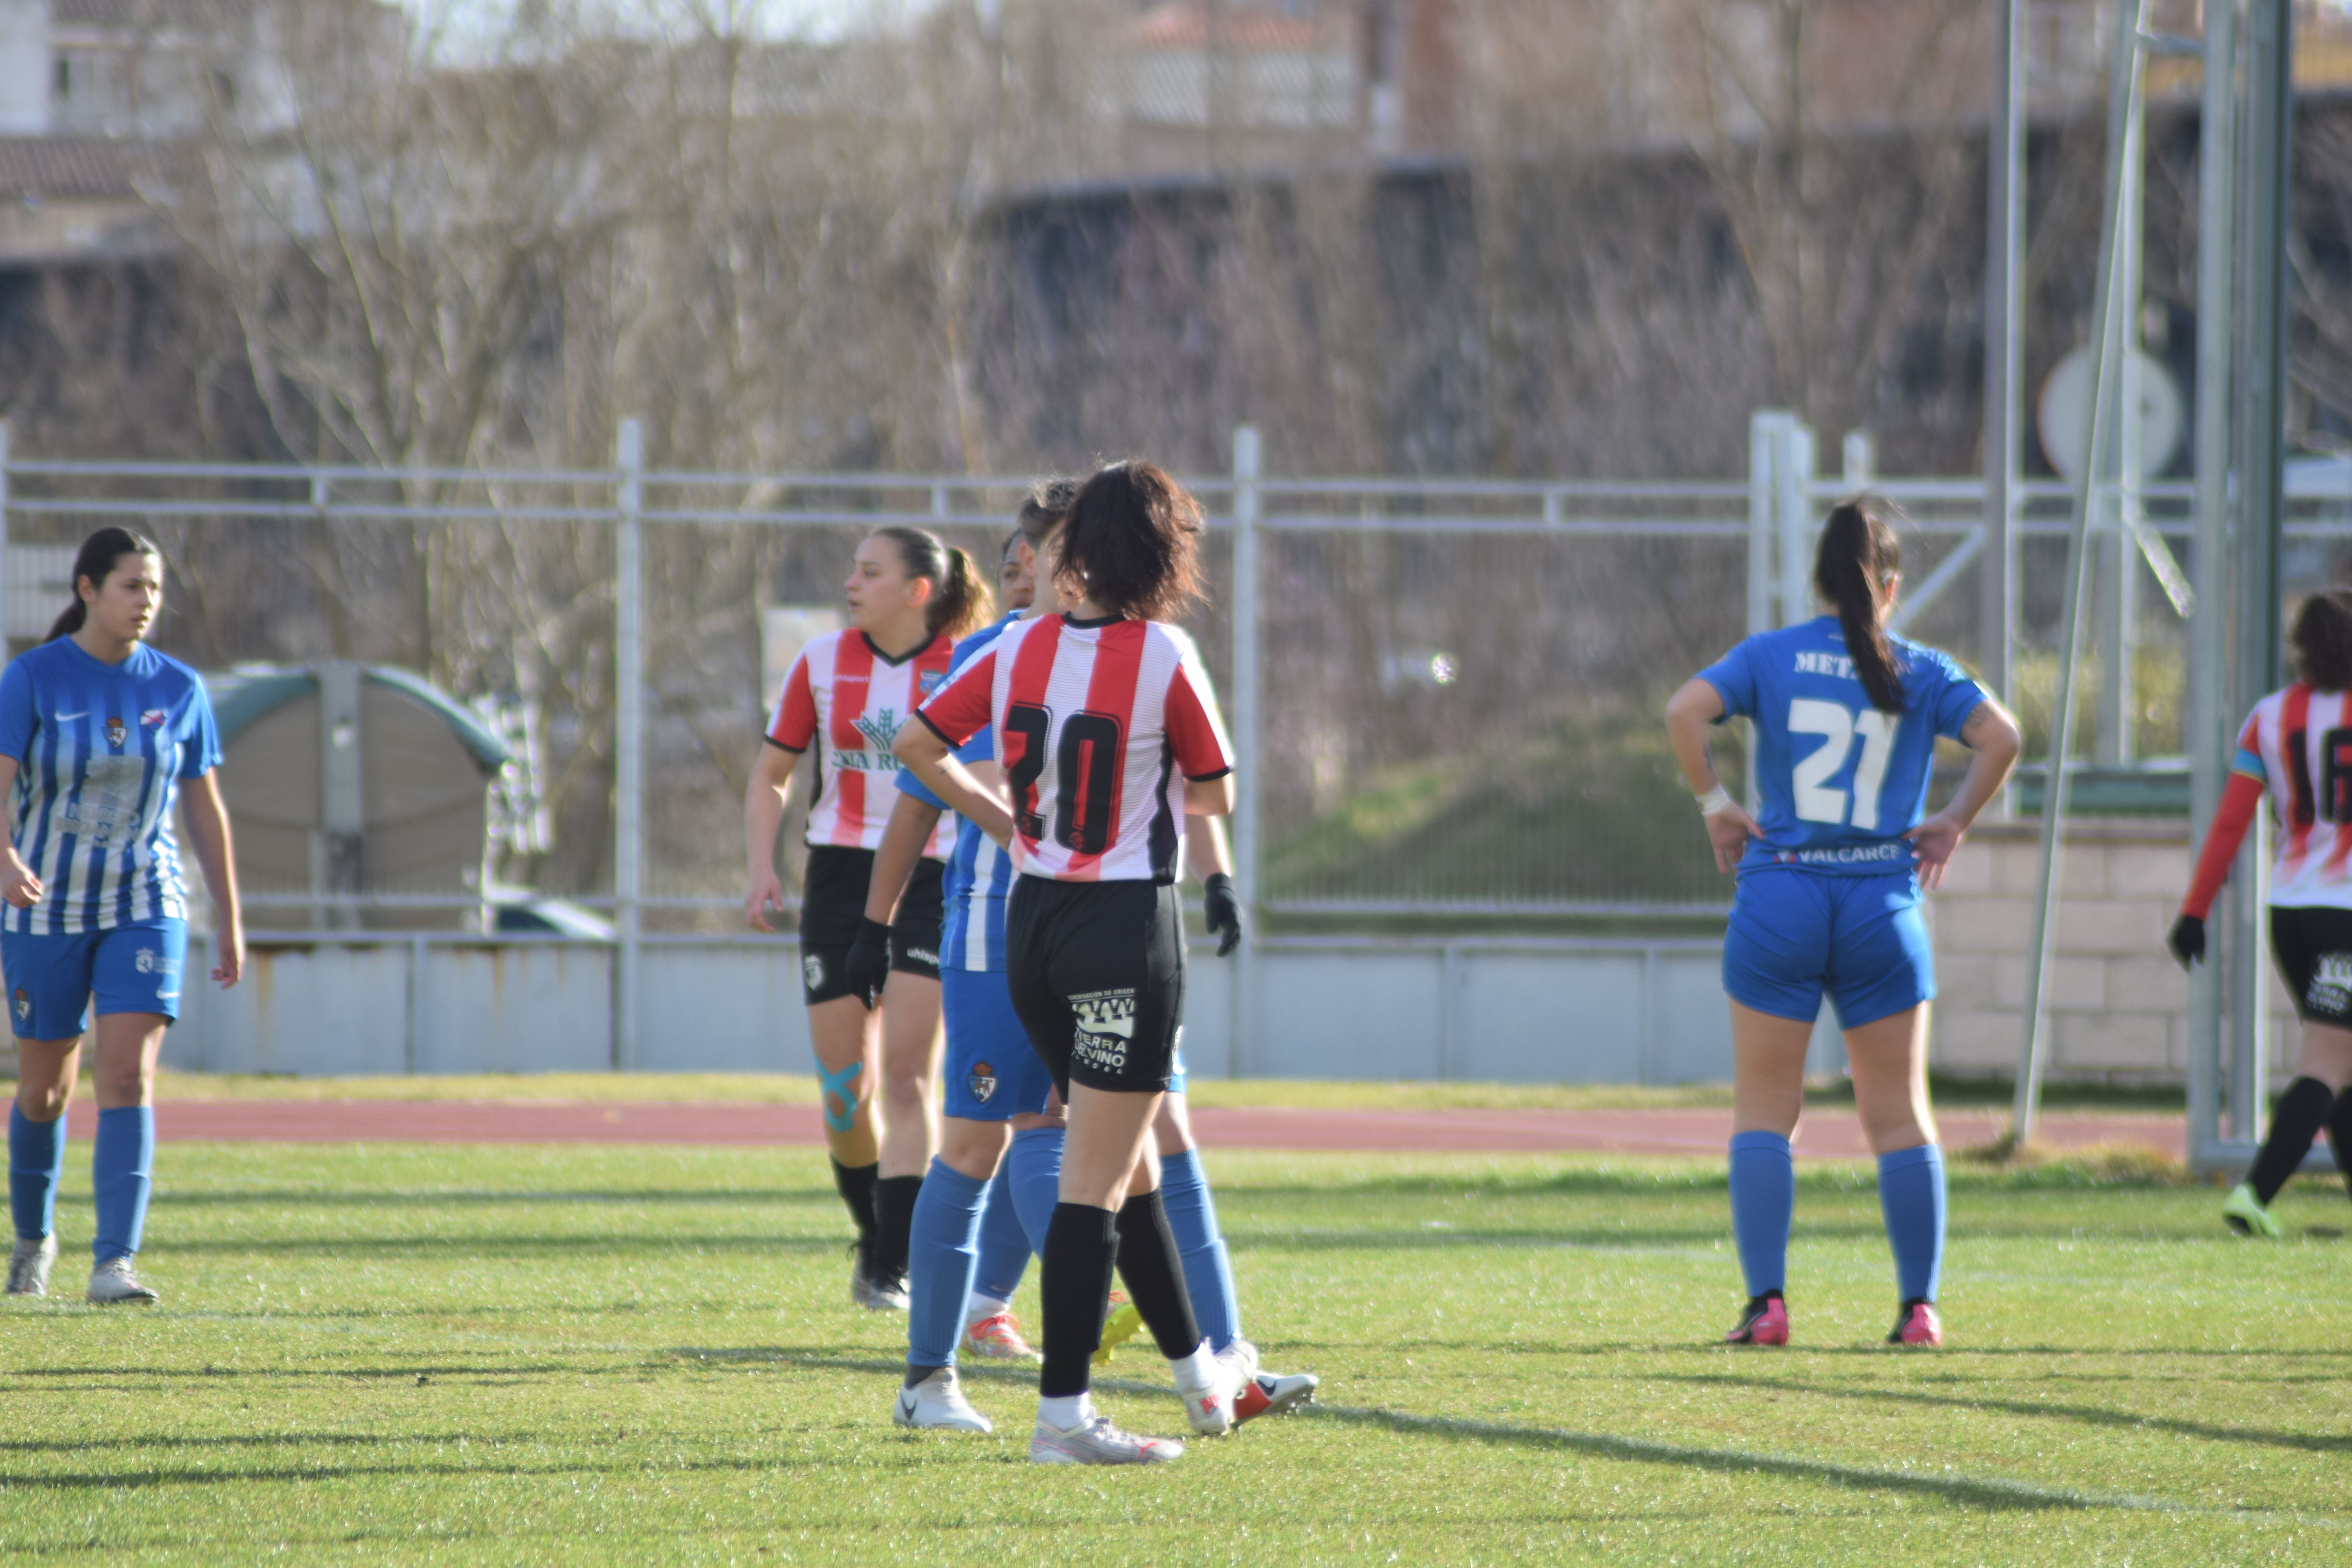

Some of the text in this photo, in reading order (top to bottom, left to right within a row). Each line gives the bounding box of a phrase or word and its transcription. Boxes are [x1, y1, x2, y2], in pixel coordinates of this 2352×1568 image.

[1005, 701, 1122, 855] 20
[1788, 698, 1900, 831] 21
[1798, 844, 1898, 863] VALCARCE
[1074, 1026, 1127, 1054] TIERRA
[1087, 1047, 1125, 1067] VINO
